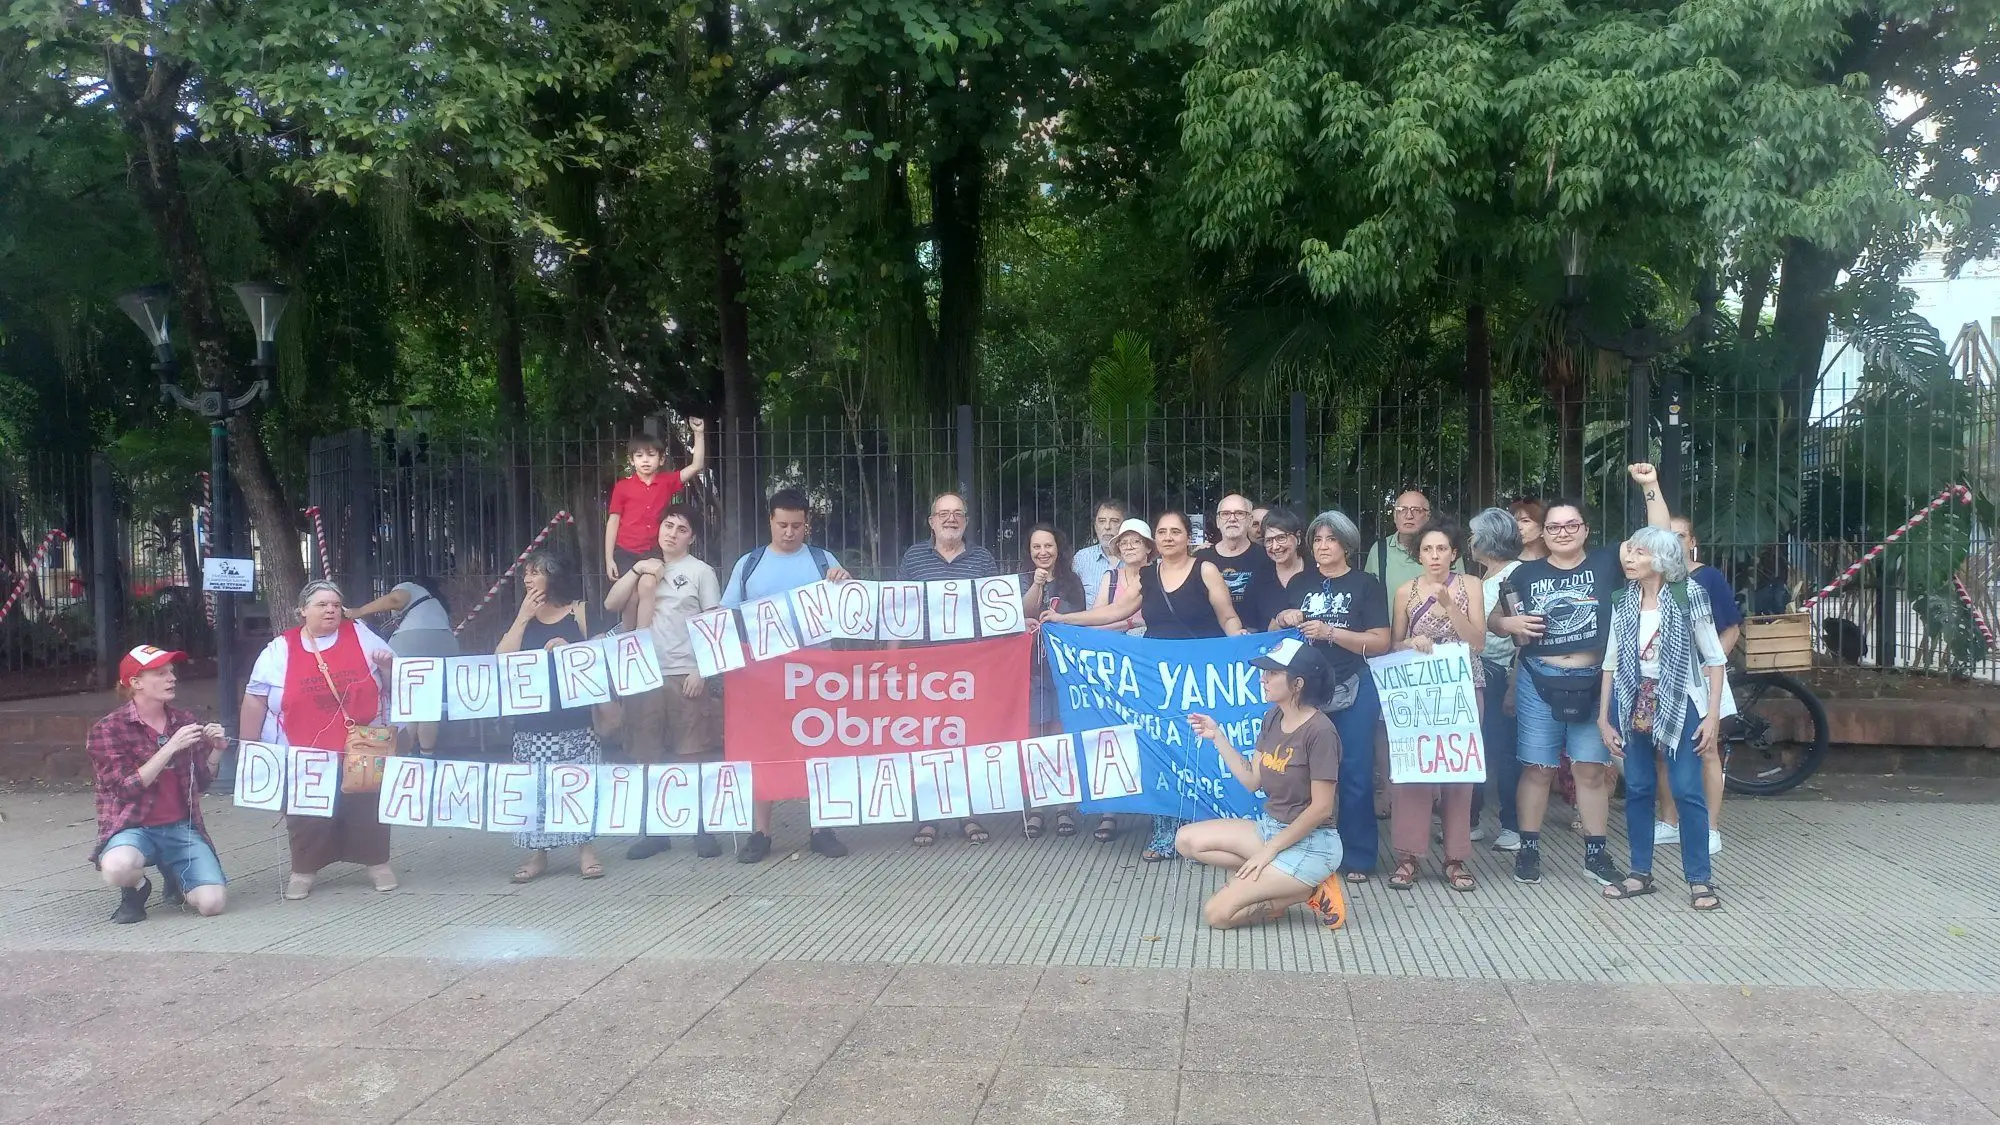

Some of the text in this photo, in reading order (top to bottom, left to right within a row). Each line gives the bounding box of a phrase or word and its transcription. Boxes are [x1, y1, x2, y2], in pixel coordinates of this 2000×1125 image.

[1531, 578, 1556, 598] PINK
[1560, 570, 1595, 587] FLOYD
[398, 635, 659, 716] FUERA
[784, 661, 976, 701] Política
[1372, 655, 1472, 690] VENEZUELA
[1068, 684, 1092, 710] DE
[1387, 685, 1475, 728] GAZA
[791, 708, 967, 747] Obrera
[1390, 737, 1416, 753] LUEGO
[1417, 732, 1482, 774] CASA
[242, 743, 330, 809] DE
